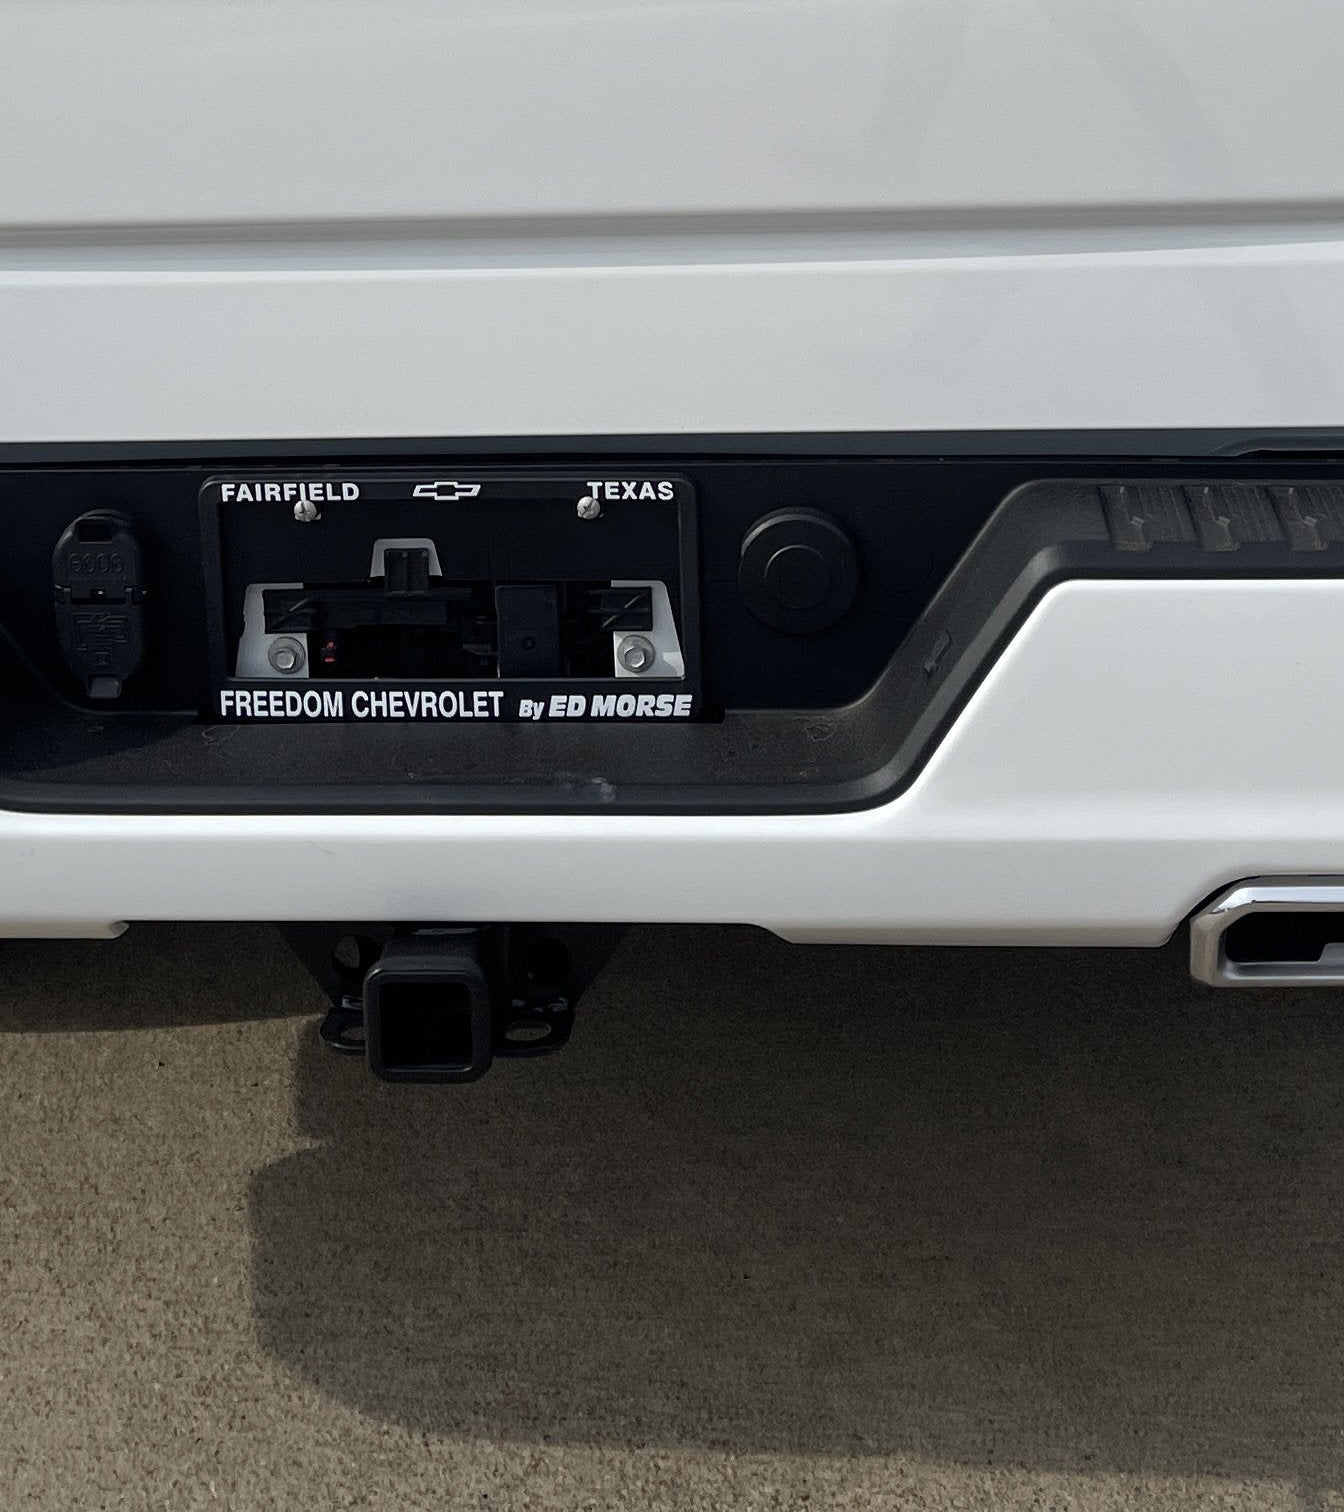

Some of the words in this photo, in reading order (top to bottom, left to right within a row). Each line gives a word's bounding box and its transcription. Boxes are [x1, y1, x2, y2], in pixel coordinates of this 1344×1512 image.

[220, 481, 361, 503] FAIRFIELD
[586, 480, 675, 502] TEXAS
[219, 690, 344, 719] FREEDOM
[350, 690, 505, 719] CHEVROLET
[518, 697, 546, 722] By
[548, 694, 587, 718] ED
[589, 694, 693, 719] MORSE
